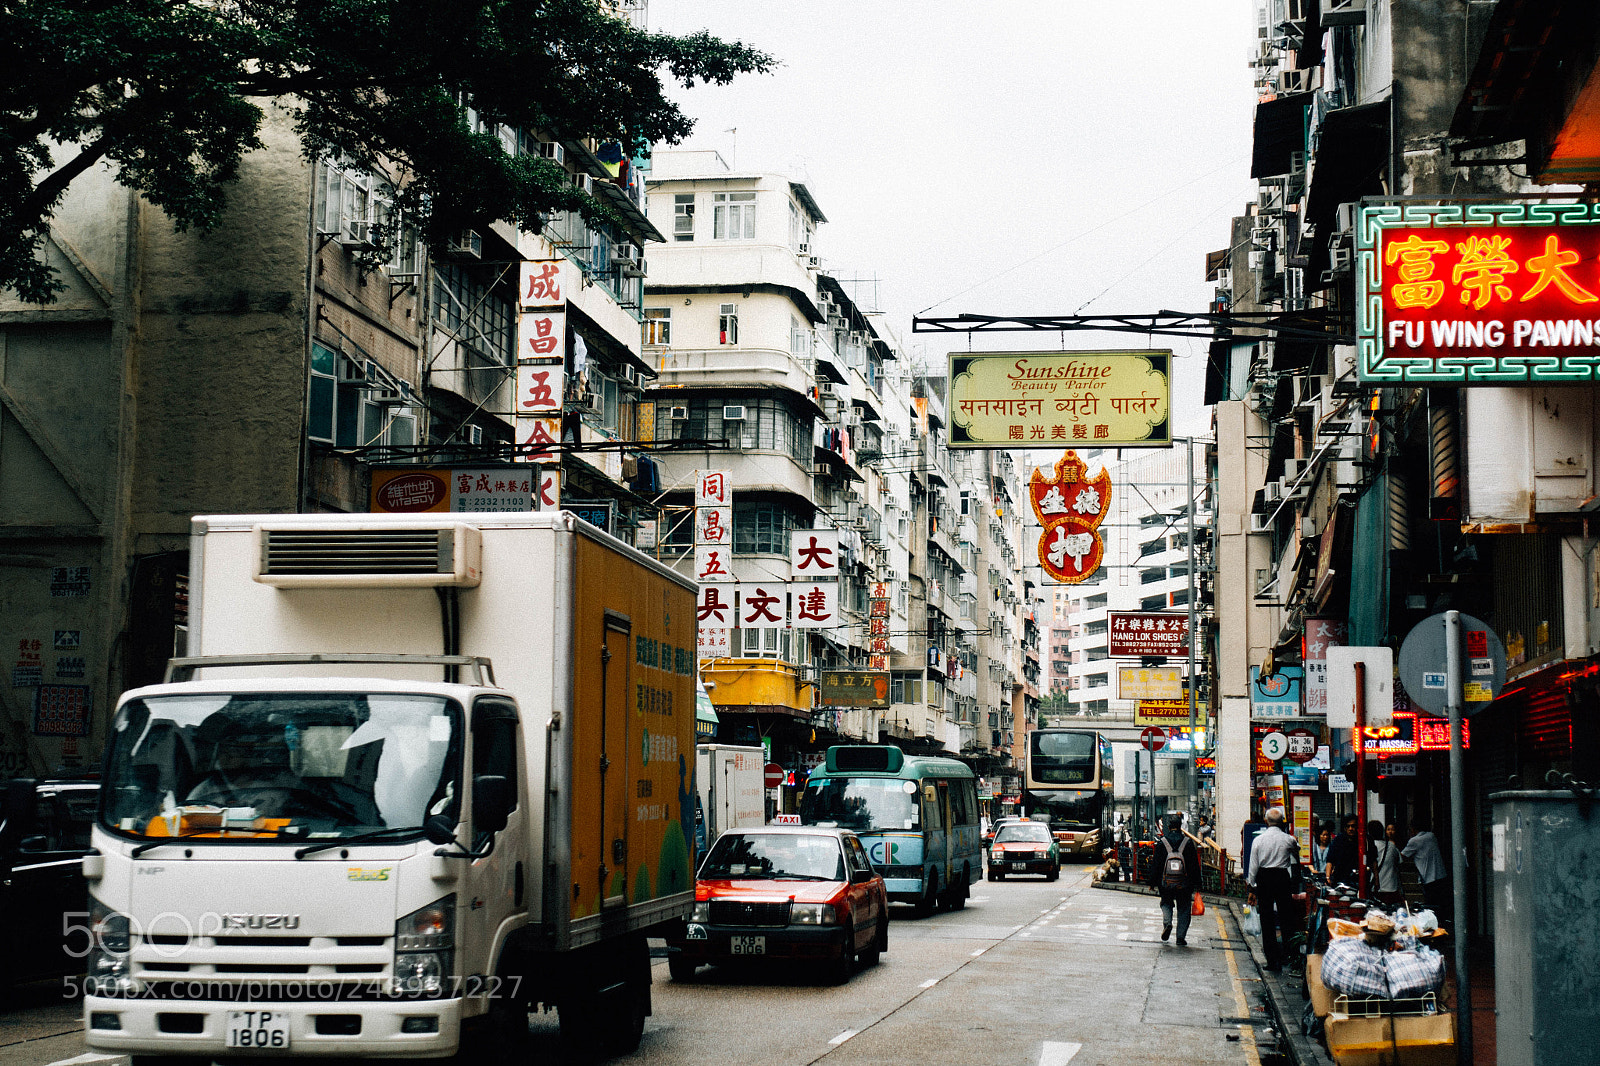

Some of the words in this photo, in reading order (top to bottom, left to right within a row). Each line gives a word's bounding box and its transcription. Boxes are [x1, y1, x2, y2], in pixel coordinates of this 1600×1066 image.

[1388, 320, 1424, 348] FU
[1431, 320, 1505, 348] WING
[1007, 358, 1112, 379] Sunshine
[1011, 380, 1058, 393] Beauty
[1065, 379, 1107, 390] Parlor
[1008, 424, 1109, 440] 陽光美髮廊
[387, 479, 434, 499] 維他奶
[457, 473, 530, 495] 富成快餐店
[388, 493, 435, 508] vitasoy
[474, 497, 497, 506] 2332
[500, 497, 524, 506] 1103
[797, 536, 834, 570] 大
[1047, 525, 1094, 572] 押
[1112, 632, 1134, 641] HANG
[1135, 632, 1151, 641] LOK
[1152, 632, 1179, 641] SHOES
[826, 674, 873, 687] 海立方
[1256, 704, 1293, 717] 光度準確
[1268, 739, 1279, 754] 3
[778, 814, 800, 825] TAXI
[222, 912, 301, 930] ISUZU
[740, 935, 756, 946] KB
[734, 945, 763, 955] 9106
[243, 1012, 272, 1028] TP
[231, 1028, 285, 1047] 1806
